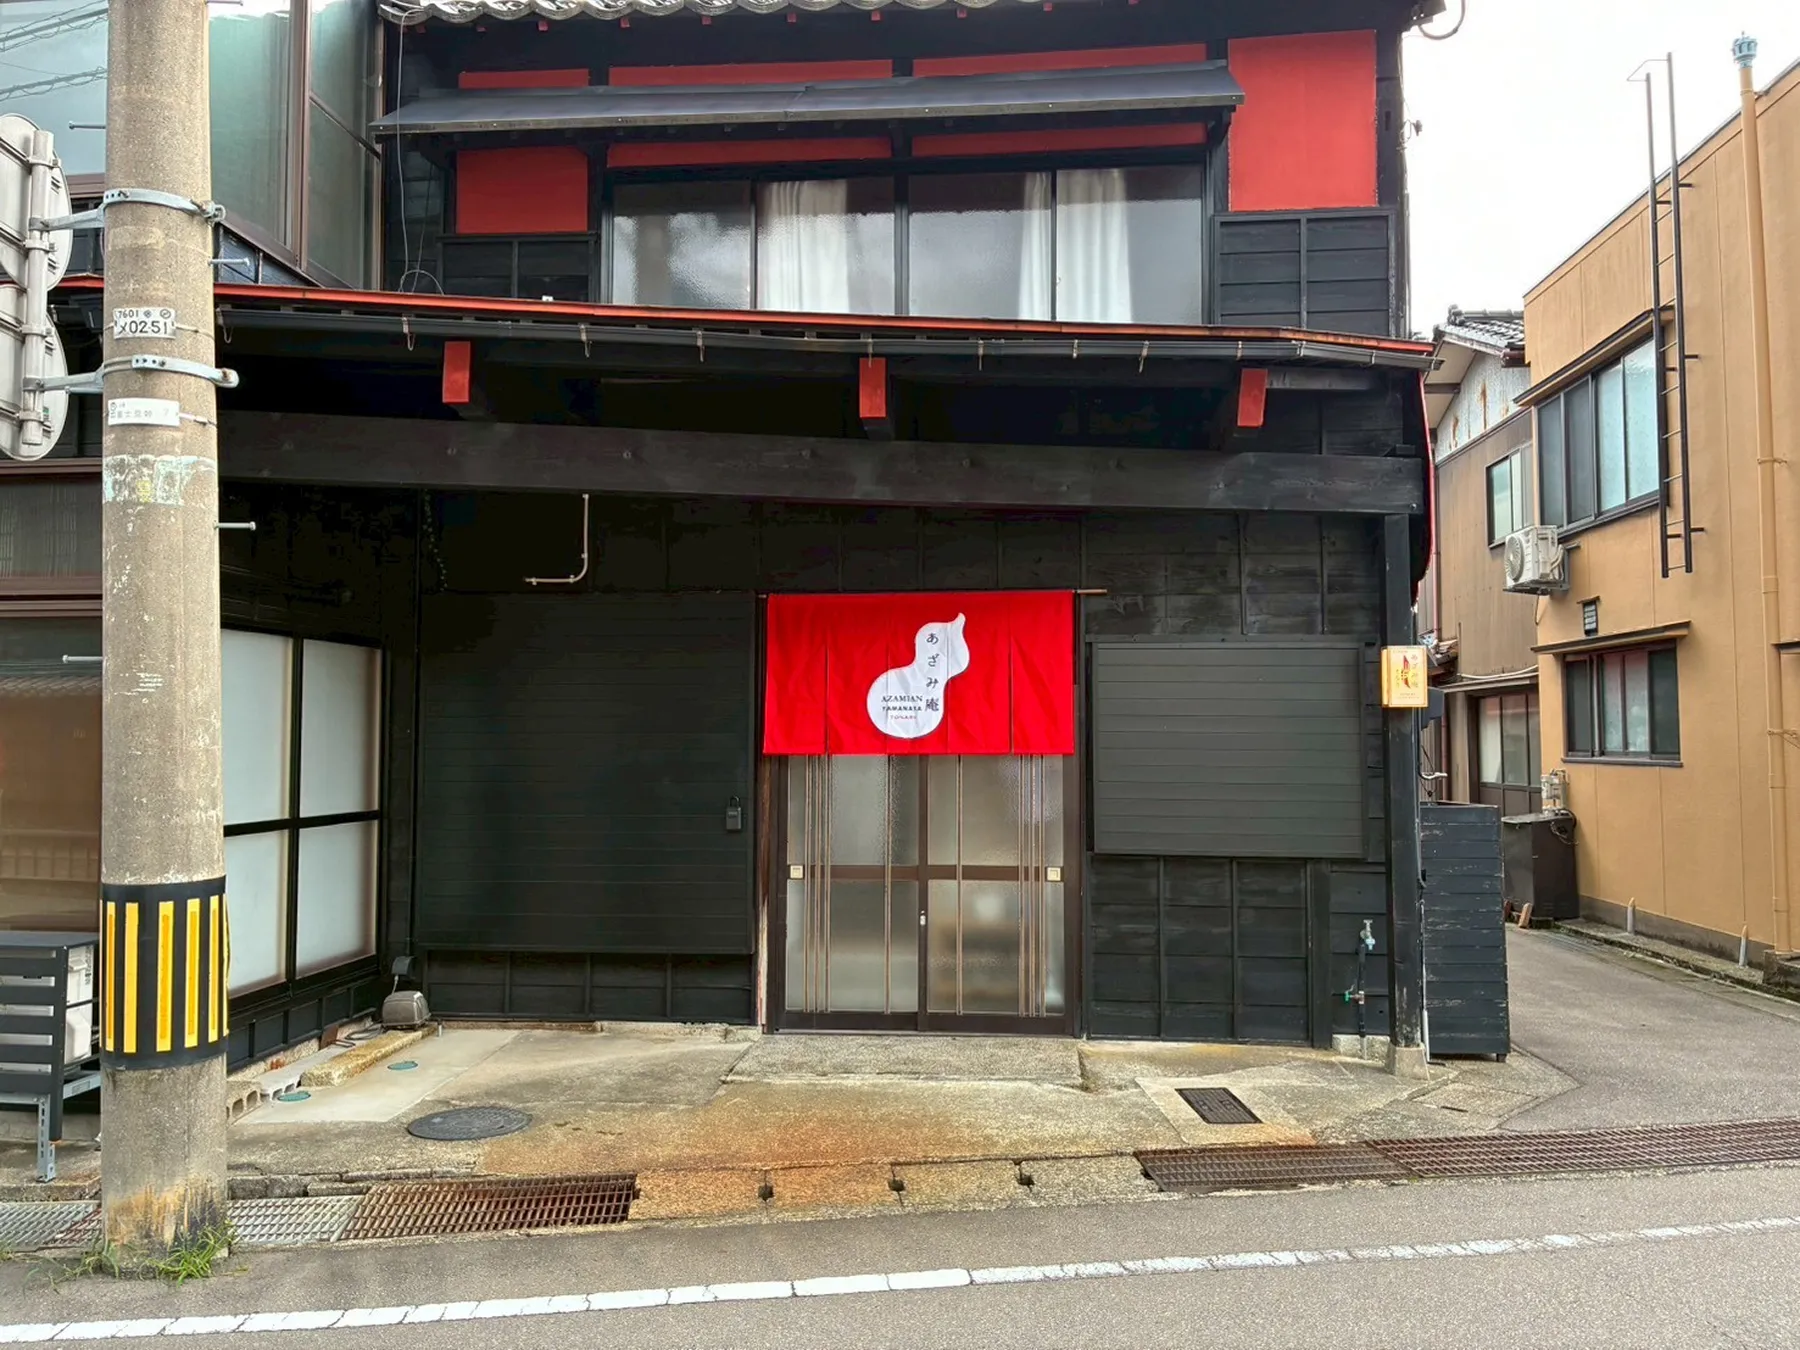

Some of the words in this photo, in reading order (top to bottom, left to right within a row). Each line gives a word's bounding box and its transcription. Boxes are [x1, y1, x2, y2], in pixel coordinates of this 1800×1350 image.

[925, 632, 940, 712] あざみ庵
[881, 695, 923, 703] AZAMIAN
